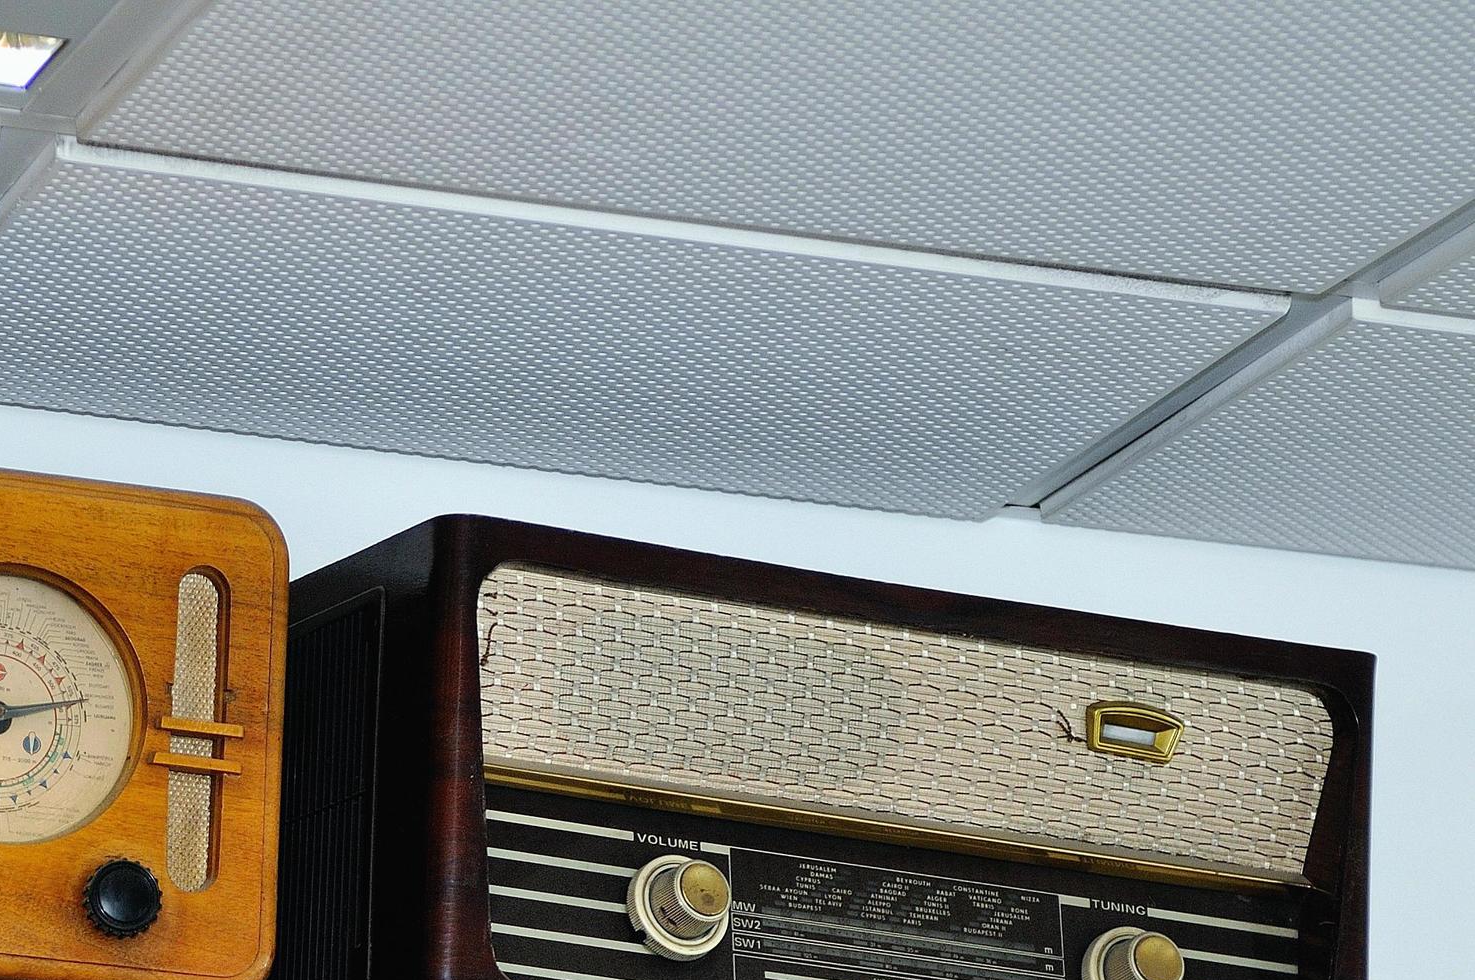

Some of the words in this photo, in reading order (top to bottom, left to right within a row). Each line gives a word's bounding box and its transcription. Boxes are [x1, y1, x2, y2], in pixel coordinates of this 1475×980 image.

[636, 832, 699, 851] VOLUME
[798, 863, 837, 873] JERUSALEM
[795, 875, 821, 885] CYPRUS
[809, 871, 834, 880] DAMAS
[796, 882, 816, 890] TUNIS
[882, 881, 903, 890] CAIRO
[896, 877, 931, 887] BEYROUTH
[831, 887, 853, 896] CAIRO
[936, 889, 956, 897] RABAT
[952, 885, 999, 897] CONSTANTINE
[824, 893, 842, 901] LYON
[870, 893, 898, 902] ATHINAI
[926, 895, 947, 903] ALGER
[968, 894, 1002, 904] VATICANO
[1020, 895, 1040, 903] NIZZA
[732, 900, 756, 913] MW
[788, 902, 822, 912] BUDAPEST
[815, 898, 826, 906] TEL
[827, 900, 842, 908] AVIV
[867, 900, 891, 908] ALEPPO
[924, 900, 943, 909] TUNIS
[1091, 899, 1146, 916] TUNING
[862, 905, 894, 916] ISTANBUL
[915, 906, 951, 917] BRUXELLES
[860, 912, 886, 921] CYPRUS
[909, 912, 939, 921] TEHERAN
[994, 911, 1031, 921] JERUSALEM
[732, 917, 761, 930] SW2
[903, 918, 922, 926] PARIS
[989, 917, 1013, 925] TIRANA
[981, 922, 1000, 930] ORAN
[963, 927, 996, 937] BUDAPEST
[734, 936, 761, 949] SW1
[1045, 964, 1054, 972] m
